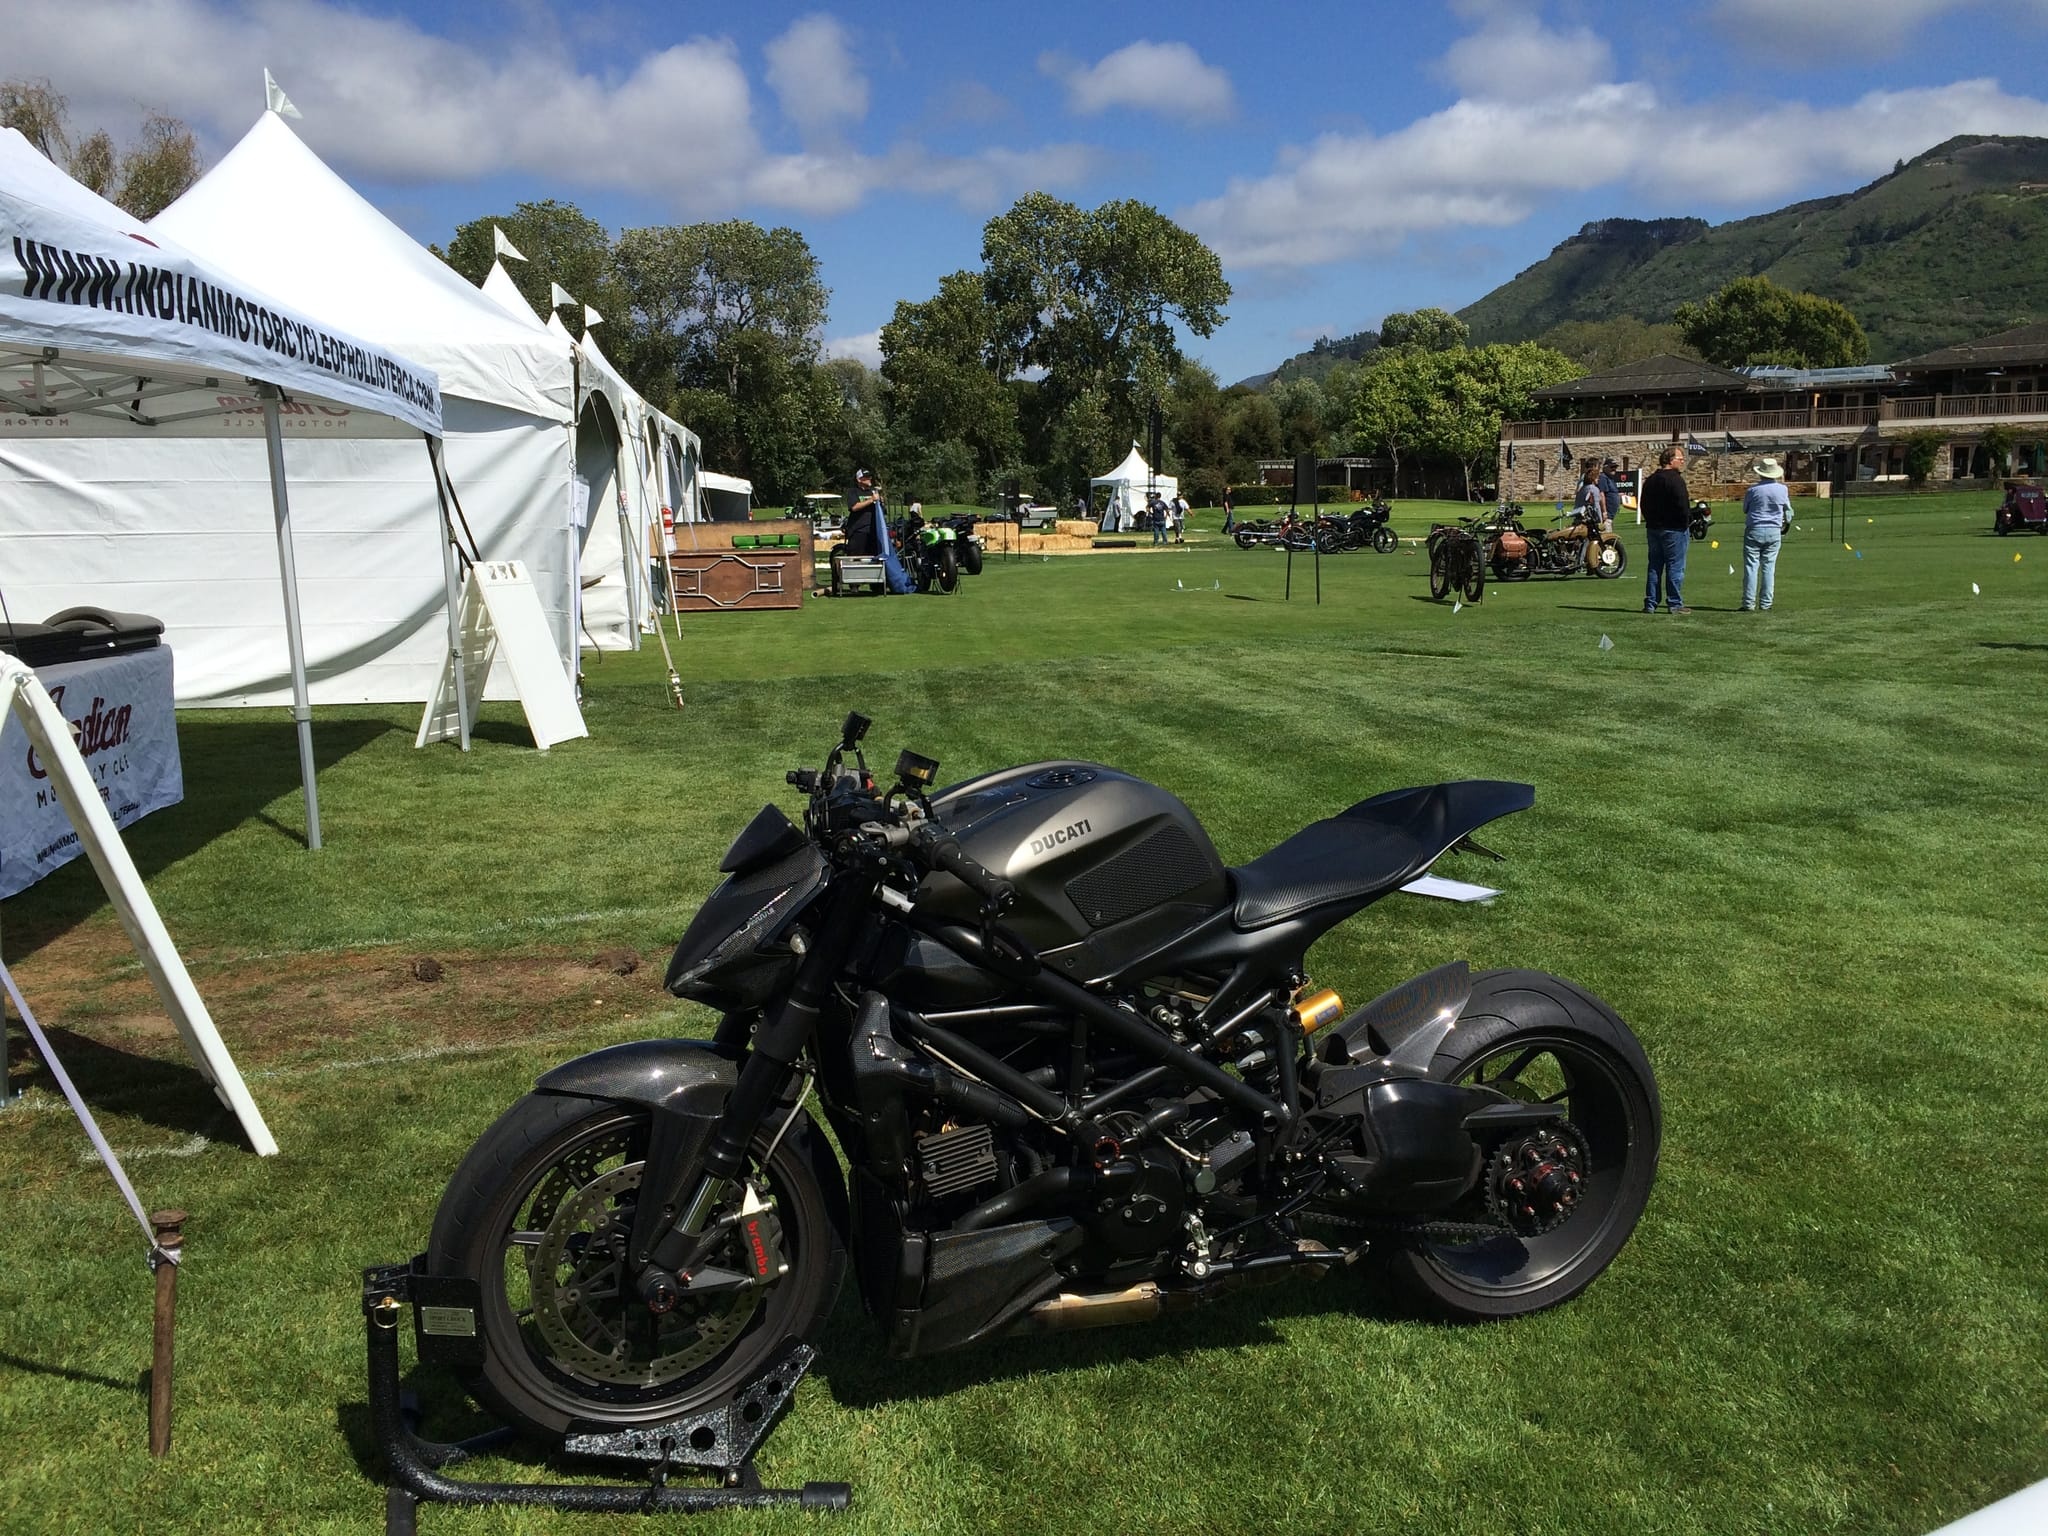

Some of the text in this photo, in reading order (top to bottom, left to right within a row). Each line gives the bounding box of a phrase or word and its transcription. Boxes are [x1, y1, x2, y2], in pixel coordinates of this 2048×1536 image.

[13, 236, 436, 415] WWW.INDIANMOTORCYCLEOFHOLLISTERCA.COM
[1030, 819, 1092, 856] DUCATI
[747, 1220, 769, 1276] brembo
